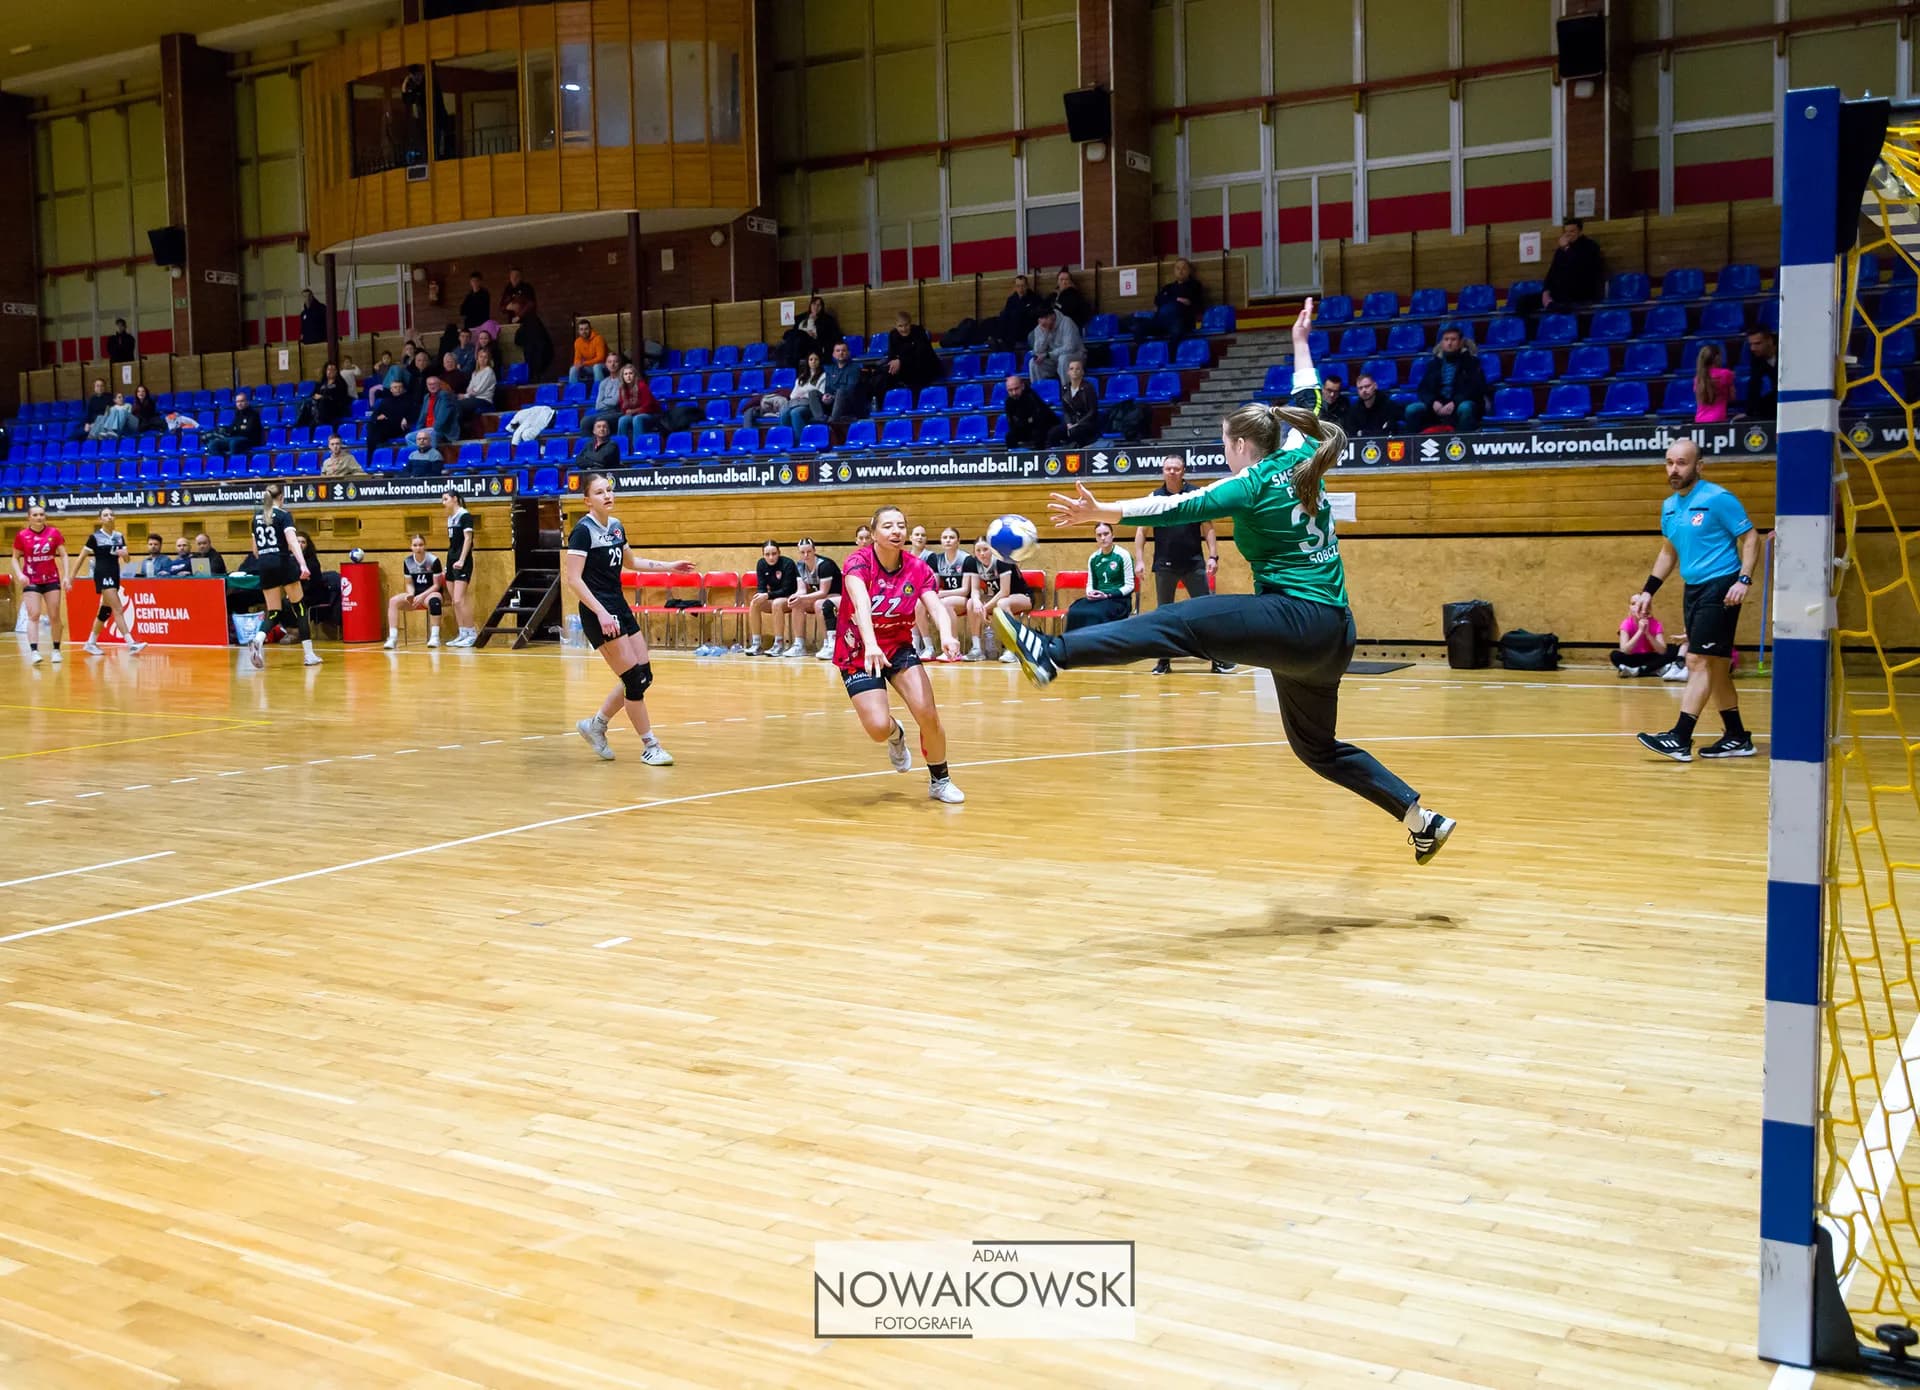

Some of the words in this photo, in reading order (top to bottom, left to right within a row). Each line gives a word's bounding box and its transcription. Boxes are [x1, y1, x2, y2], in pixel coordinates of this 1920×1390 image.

[856, 455, 1039, 477] www.koronahandball.pl
[619, 466, 774, 487] www.koronahandball.pl
[255, 526, 278, 547] 33
[609, 548, 622, 567] 29
[416, 574, 428, 584] 44
[945, 576, 958, 589] 13
[1103, 572, 1107, 583] 1
[134, 592, 156, 605] LIGA
[871, 594, 902, 618] 22
[136, 607, 190, 620] CENTRALNA
[137, 622, 169, 634] KOBIET
